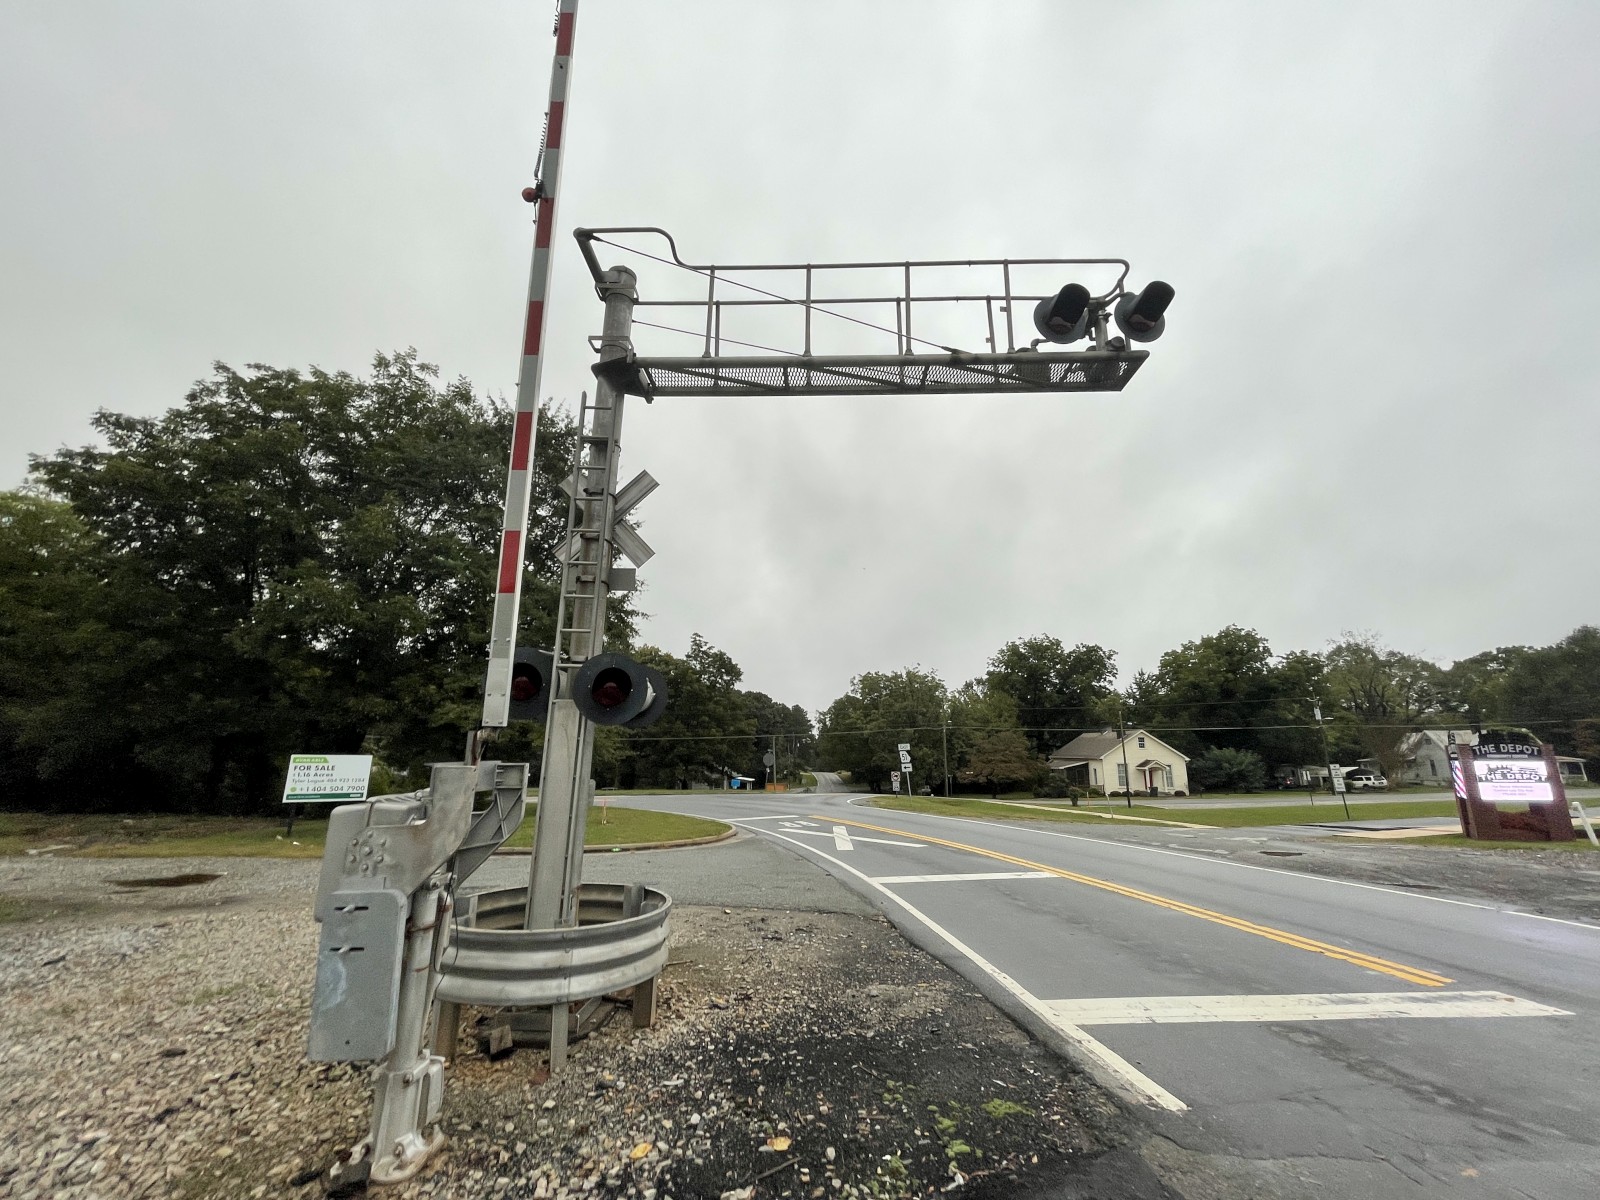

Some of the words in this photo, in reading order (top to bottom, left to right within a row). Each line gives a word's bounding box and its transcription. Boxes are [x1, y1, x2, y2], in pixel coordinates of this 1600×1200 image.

[1473, 744, 1496, 755] THE
[1500, 744, 1539, 755] DEPOT
[901, 753, 908, 761] 51
